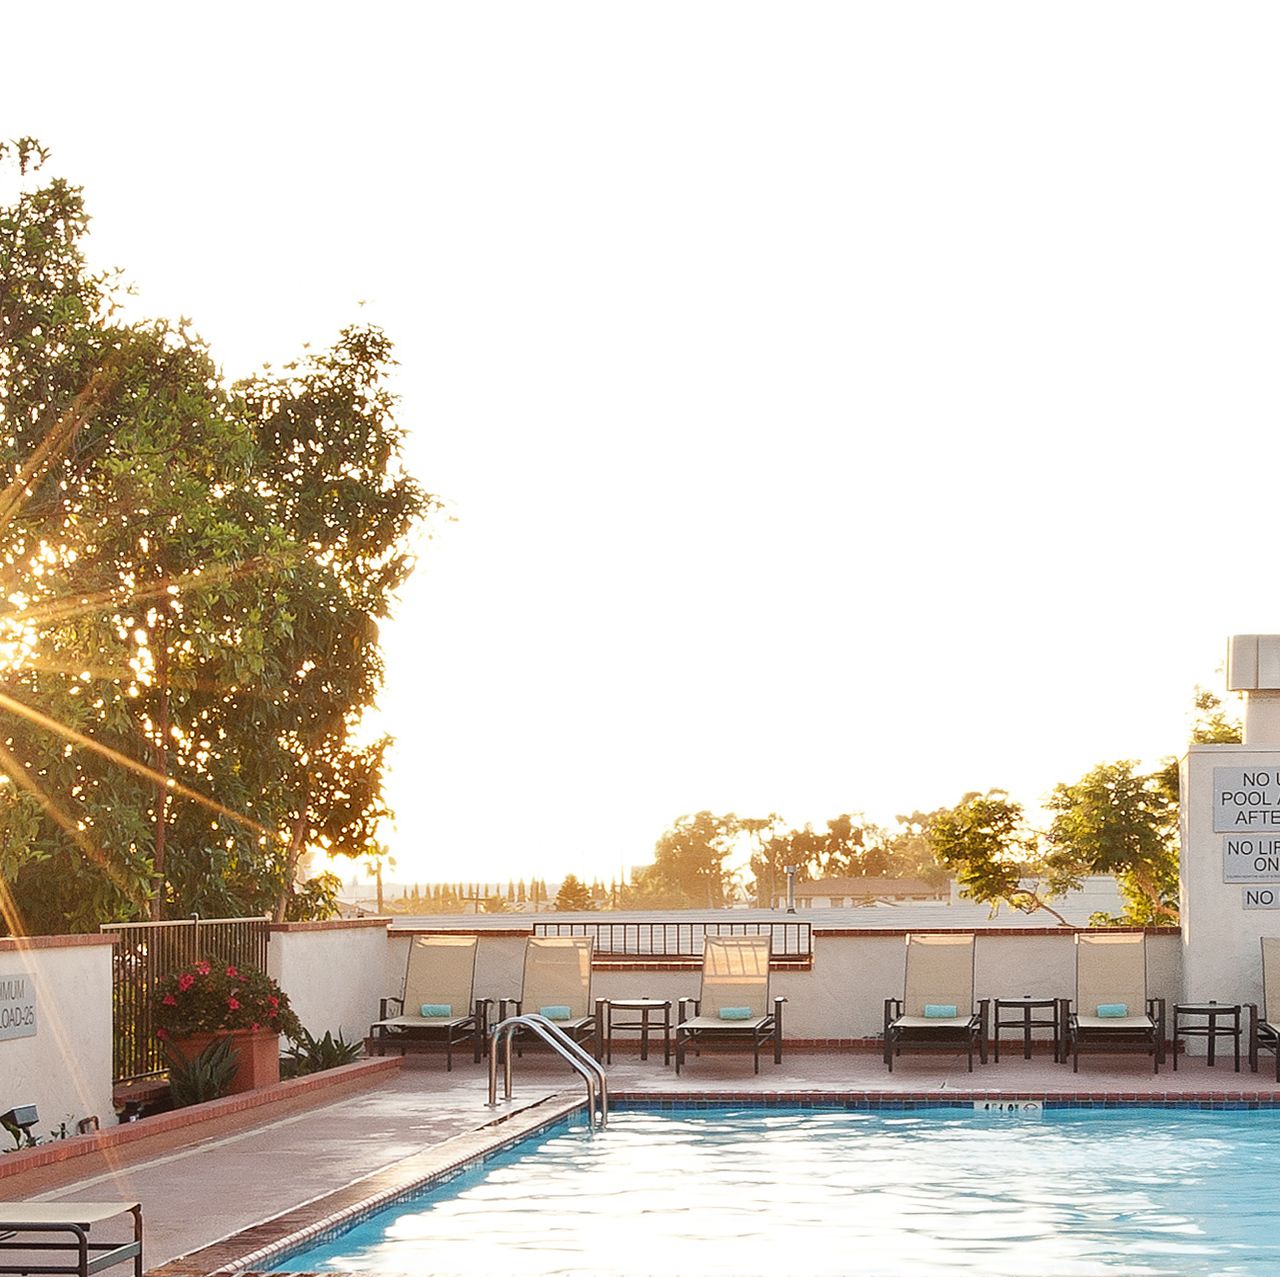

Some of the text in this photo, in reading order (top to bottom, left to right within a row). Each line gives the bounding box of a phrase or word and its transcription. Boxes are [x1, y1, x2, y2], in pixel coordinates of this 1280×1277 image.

[1243, 772, 1269, 787] NO
[1221, 791, 1271, 806] POOL
[1228, 840, 1254, 855] NO
[1253, 857, 1279, 872] ON
[1246, 890, 1273, 905] NO
